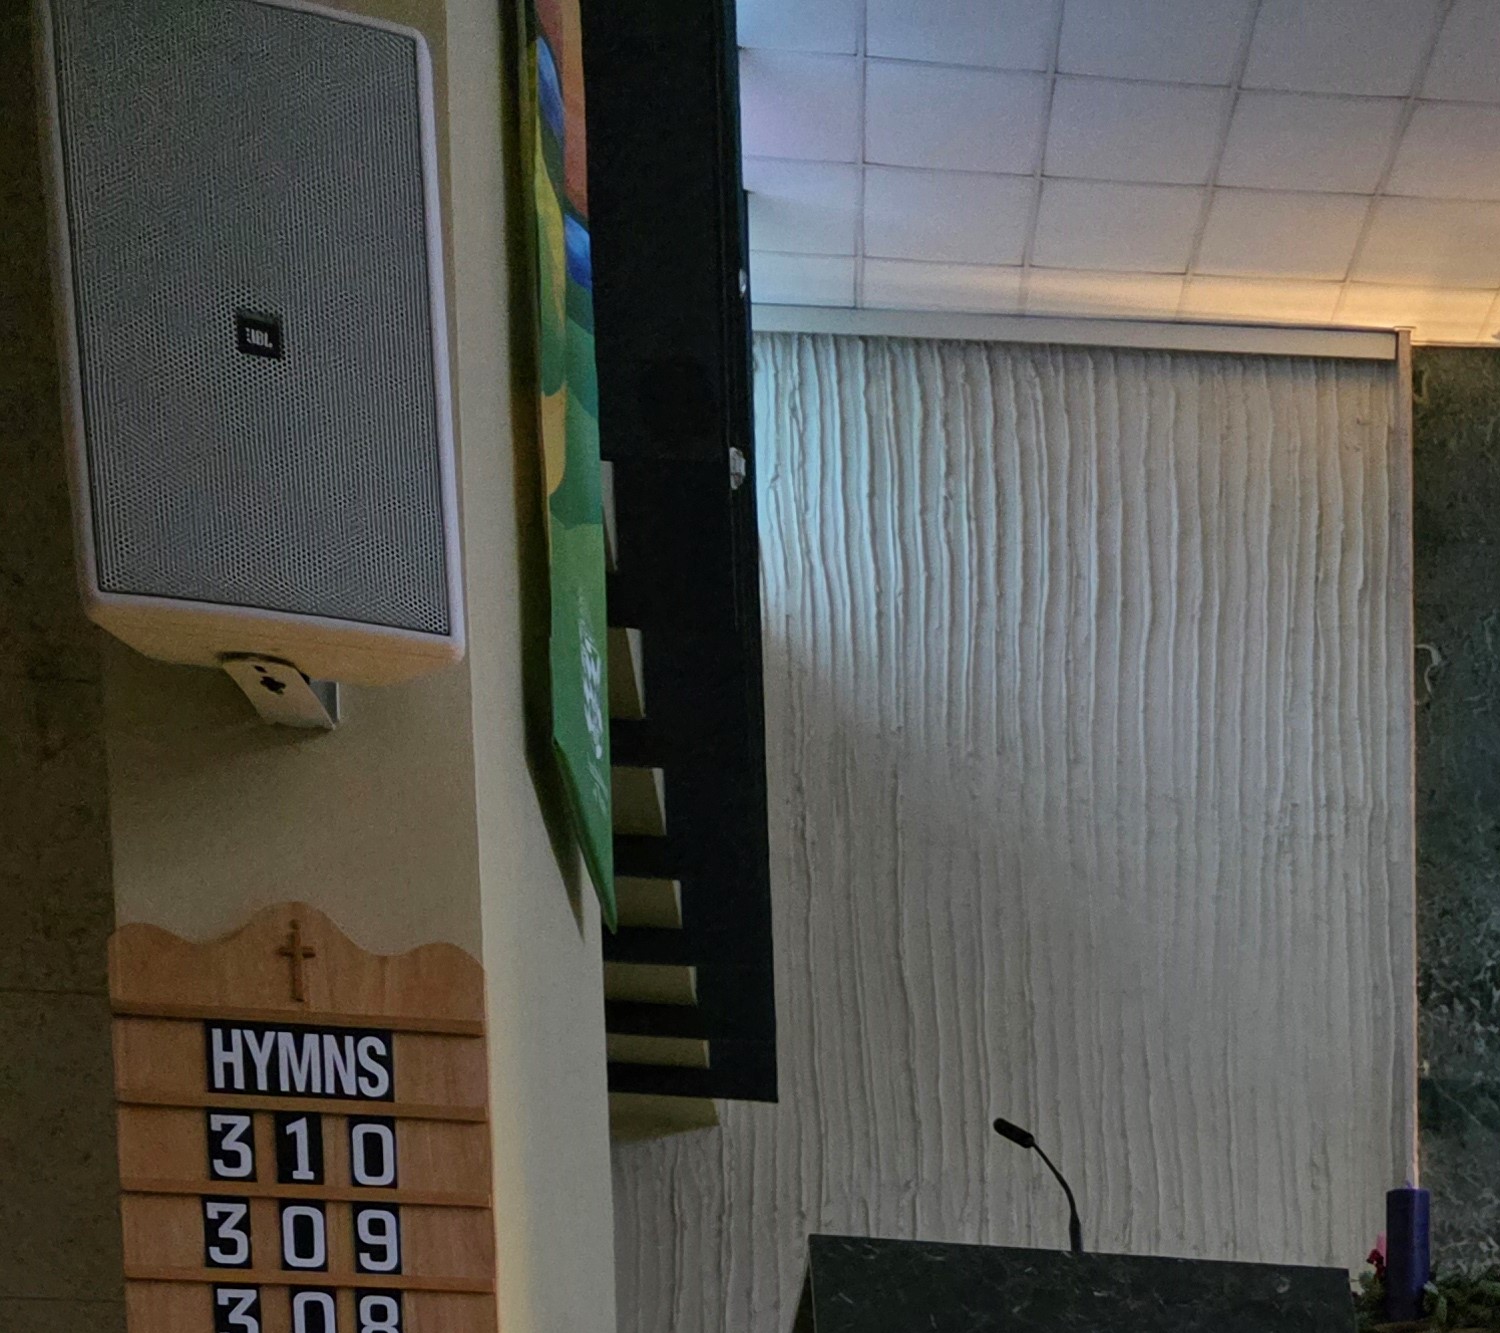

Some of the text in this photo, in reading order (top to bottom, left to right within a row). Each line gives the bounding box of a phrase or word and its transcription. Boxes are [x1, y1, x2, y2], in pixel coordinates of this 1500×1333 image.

[211, 1028, 390, 1098] HYMNS
[210, 1114, 395, 1187] 310
[206, 1202, 399, 1272] 309
